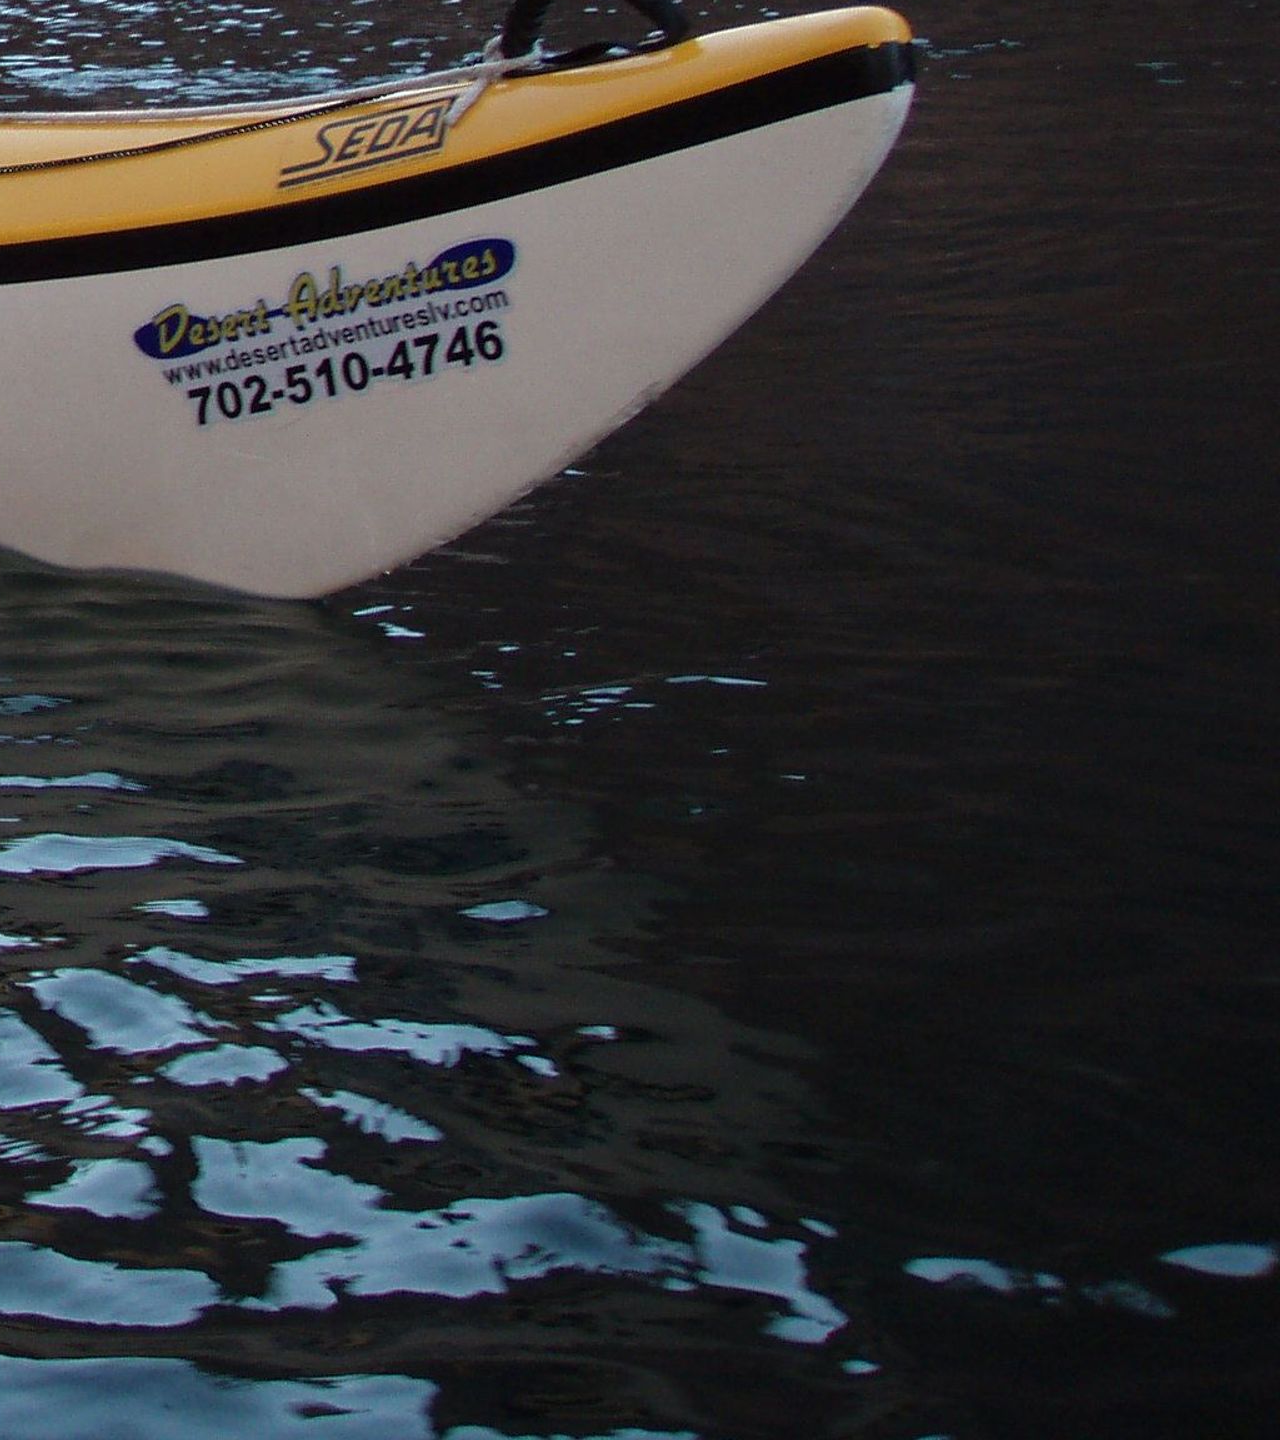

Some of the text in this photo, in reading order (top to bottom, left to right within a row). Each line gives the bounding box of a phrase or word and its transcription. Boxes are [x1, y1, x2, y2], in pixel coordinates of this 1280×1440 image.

[281, 105, 448, 176] SEDA
[151, 246, 500, 354] Desert Adventures
[162, 288, 510, 386] www.desertadventureslv.com
[187, 320, 505, 427] 702-510-4746
